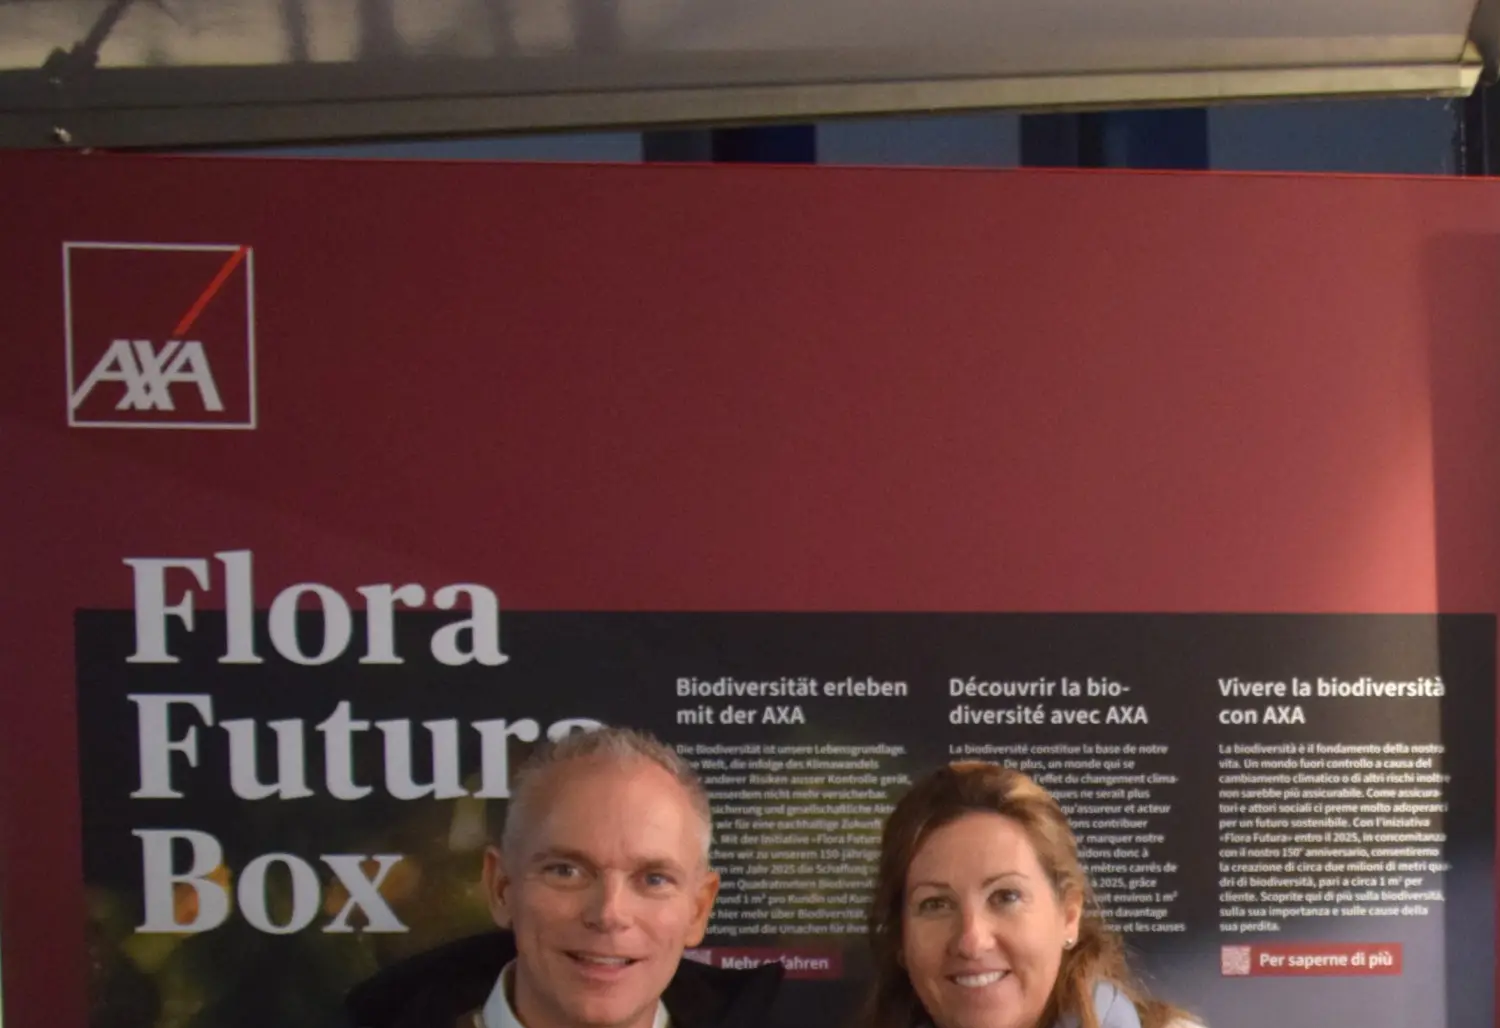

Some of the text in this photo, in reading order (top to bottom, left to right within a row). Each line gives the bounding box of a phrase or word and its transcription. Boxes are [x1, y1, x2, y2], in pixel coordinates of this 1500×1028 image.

[70, 339, 225, 411] AXA
[123, 550, 508, 666] Flora
[675, 677, 908, 697] Biodiversität erleben
[949, 676, 1131, 697] Découvrir la bio-
[1218, 676, 1446, 697] Vivere la biodiversità
[676, 705, 806, 725] mit der AXA
[949, 705, 1149, 725] diversité avec AXA
[1218, 706, 1306, 725] con AXA
[127, 694, 607, 801] Futur
[132, 828, 409, 934] Box
[1259, 951, 1393, 970] Per saperne di più
